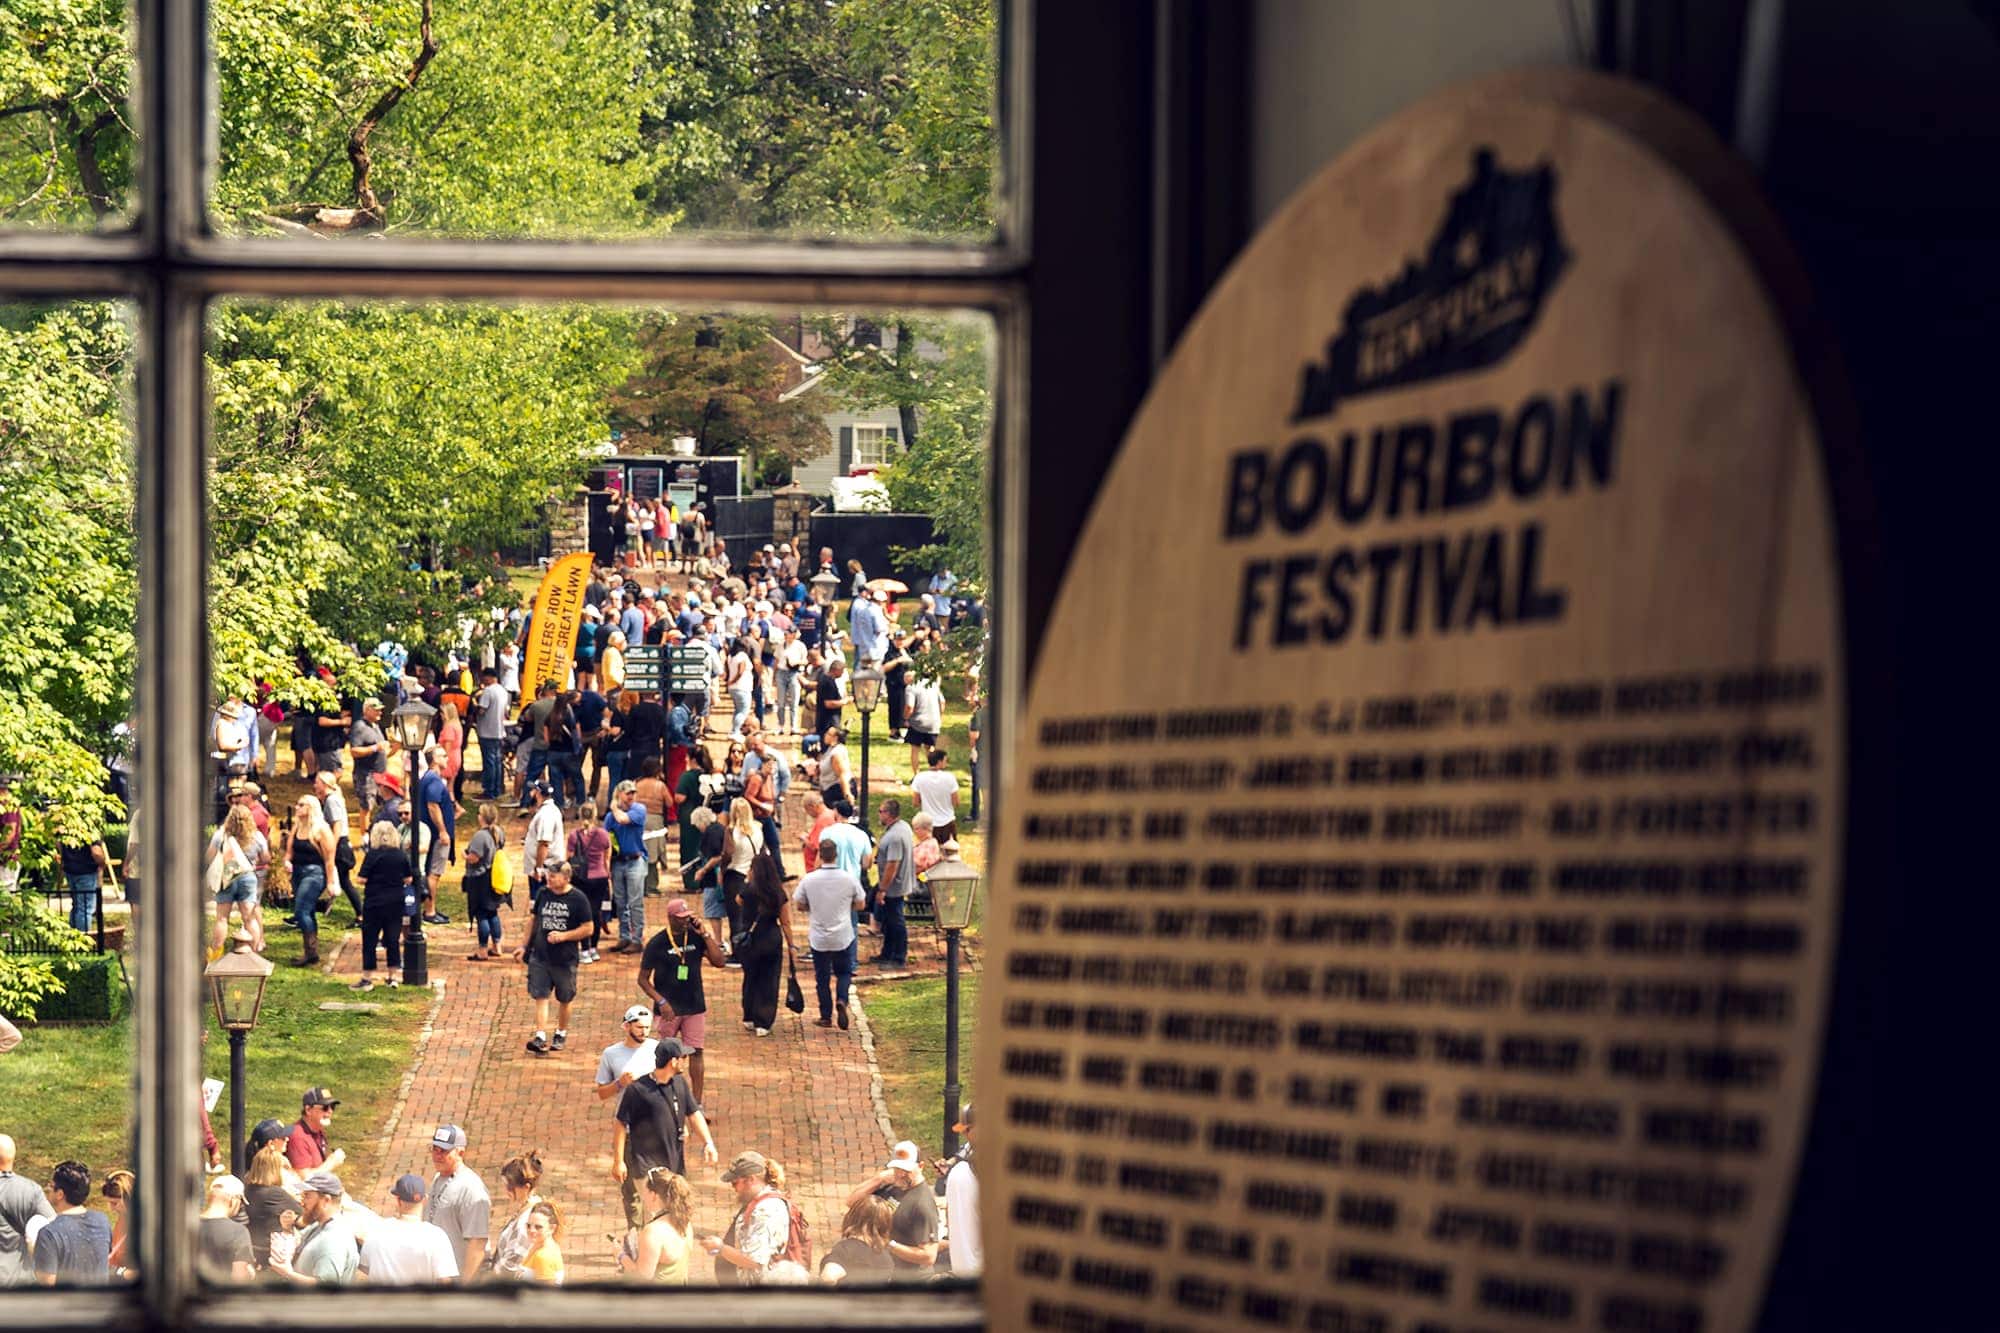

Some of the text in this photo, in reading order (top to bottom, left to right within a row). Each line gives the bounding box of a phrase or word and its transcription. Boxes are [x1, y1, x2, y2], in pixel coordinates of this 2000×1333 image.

[1358, 241, 1542, 381] KENTUCKY
[1222, 379, 1625, 542] BOURBON
[536, 585, 562, 687] ISTILLERS' ROW
[557, 608, 571, 648] GREAT
[565, 567, 582, 604] LAWN
[1234, 520, 1567, 651] FESTIVAL
[552, 652, 565, 676] THE
